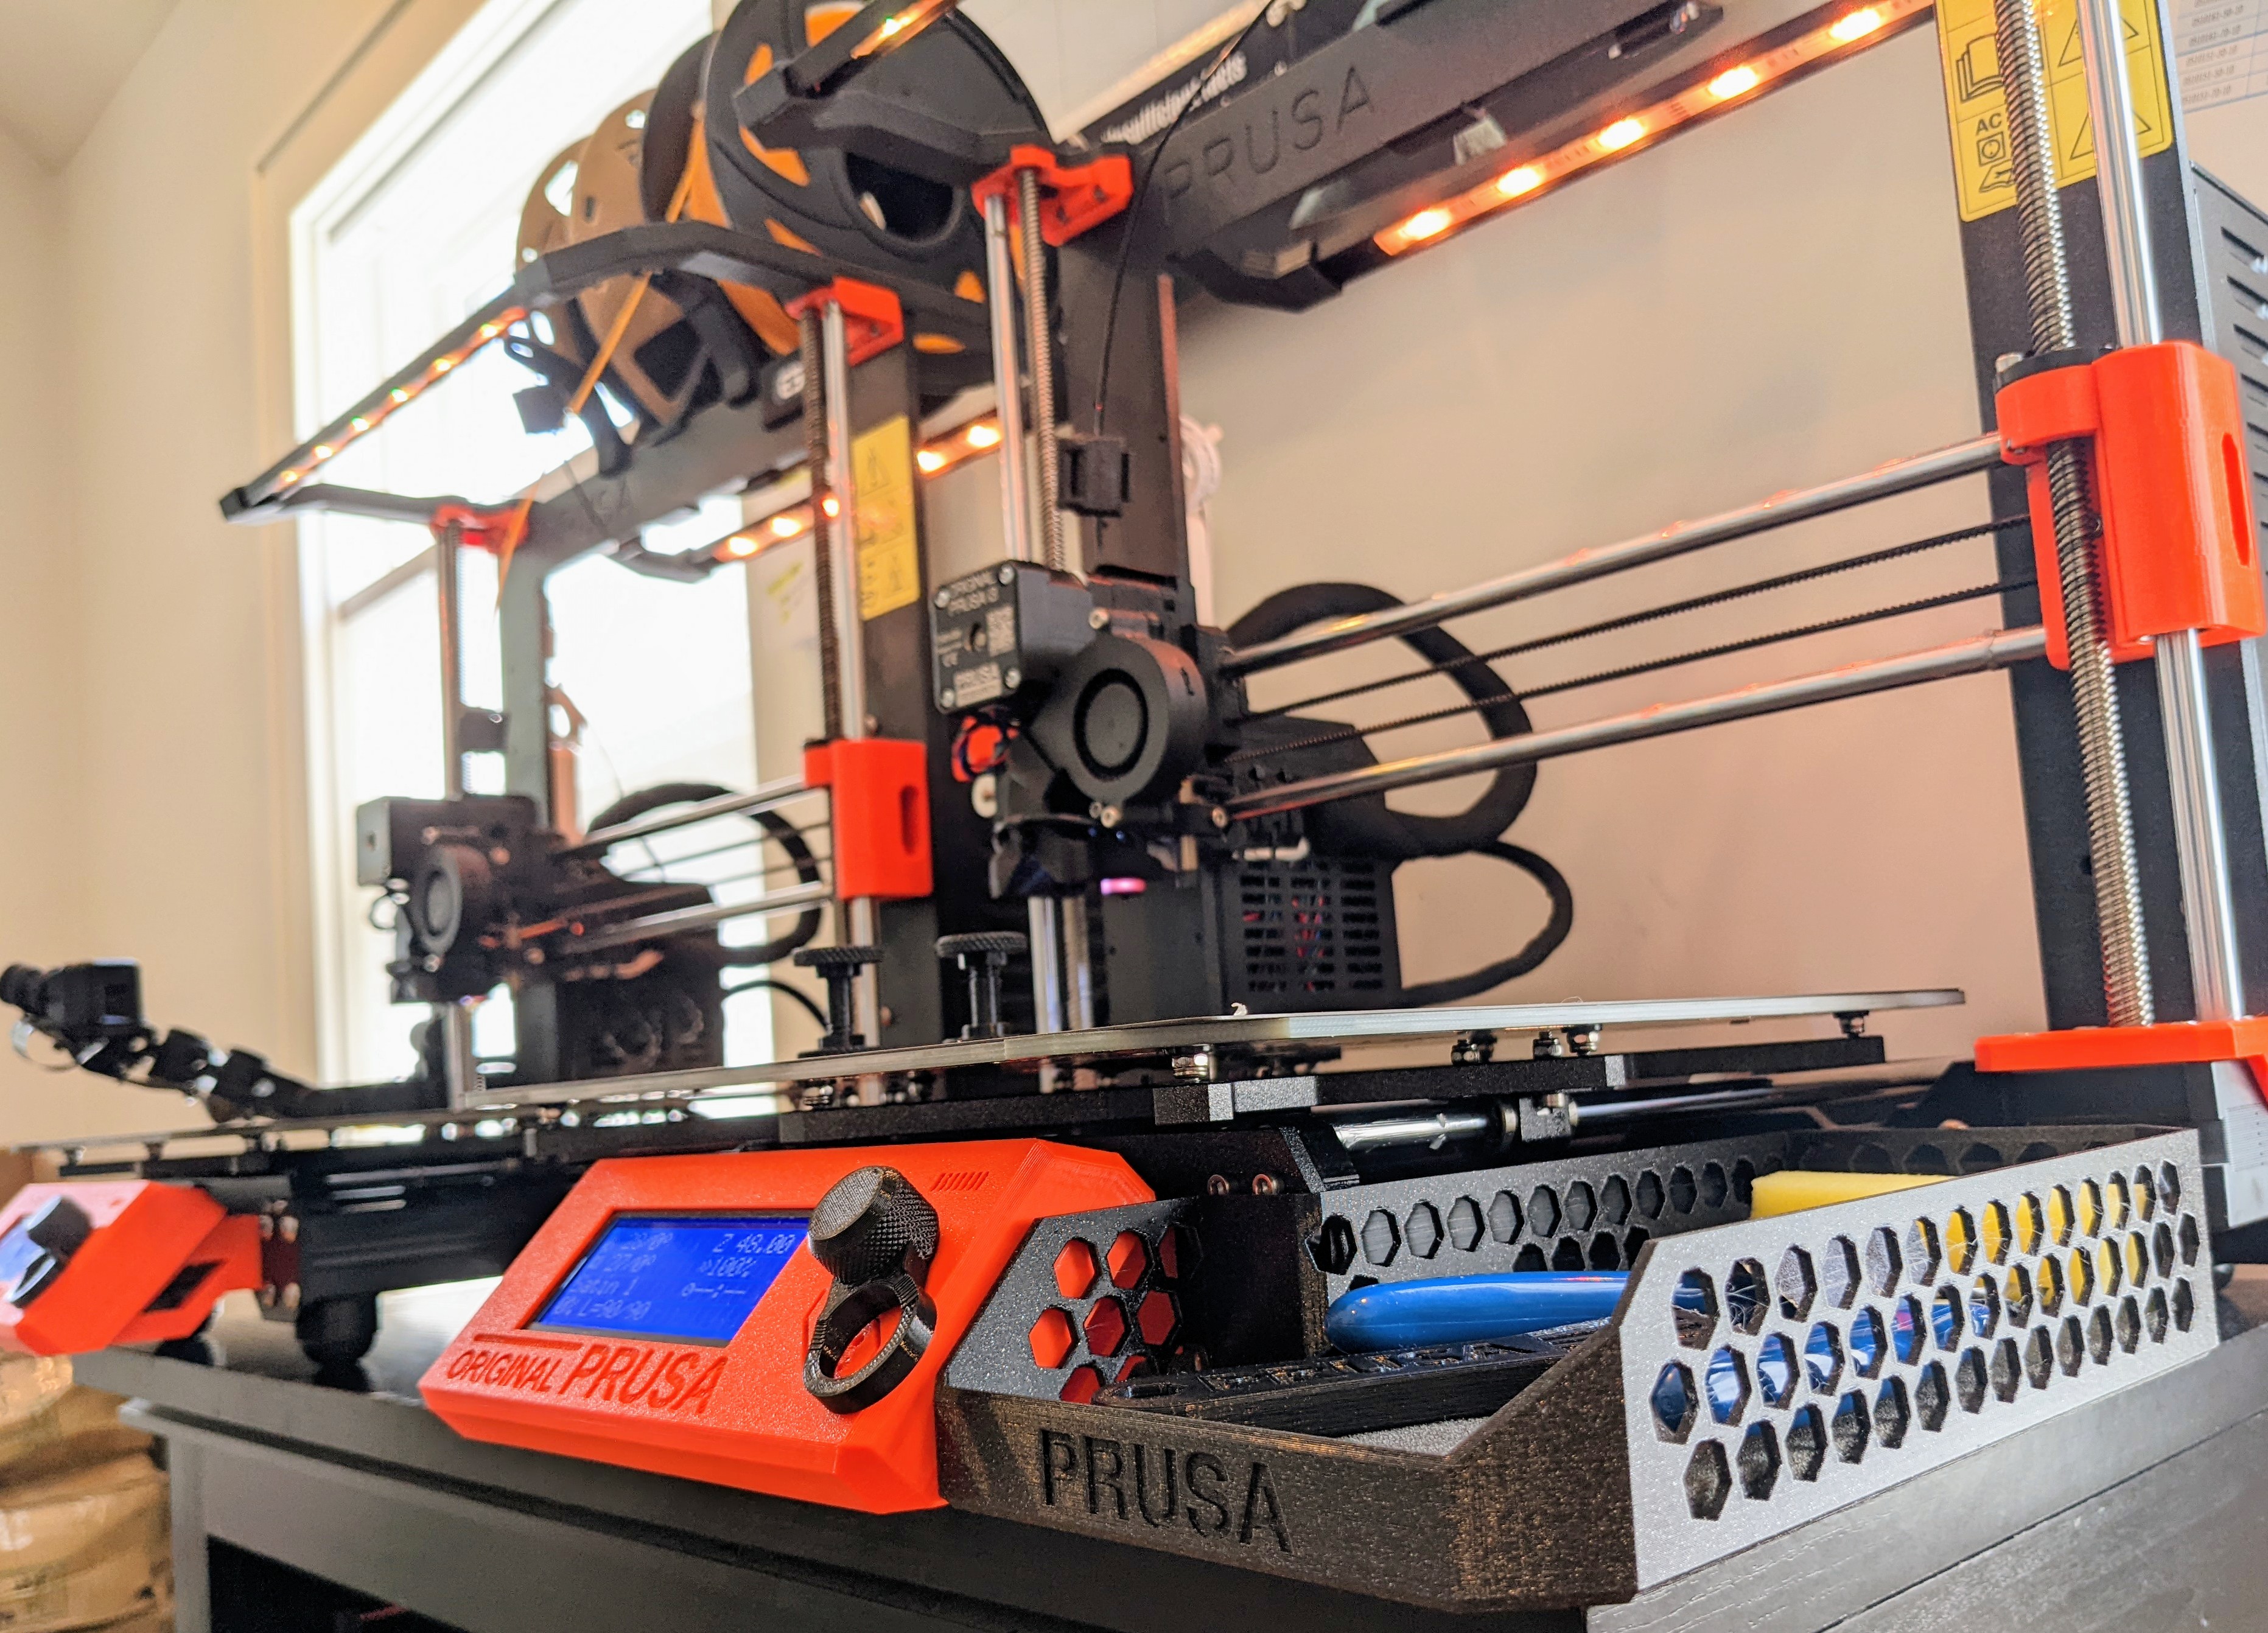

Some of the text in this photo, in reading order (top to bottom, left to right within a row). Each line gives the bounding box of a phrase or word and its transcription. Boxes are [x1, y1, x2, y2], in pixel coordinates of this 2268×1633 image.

[1163, 66, 1374, 226] PRUSA
[1976, 113, 2003, 135] AC
[736, 1233, 796, 1254] 48.00
[447, 1343, 729, 1414] ORIGINAL PRUSA
[1041, 1428, 1295, 1555] PRUSA
